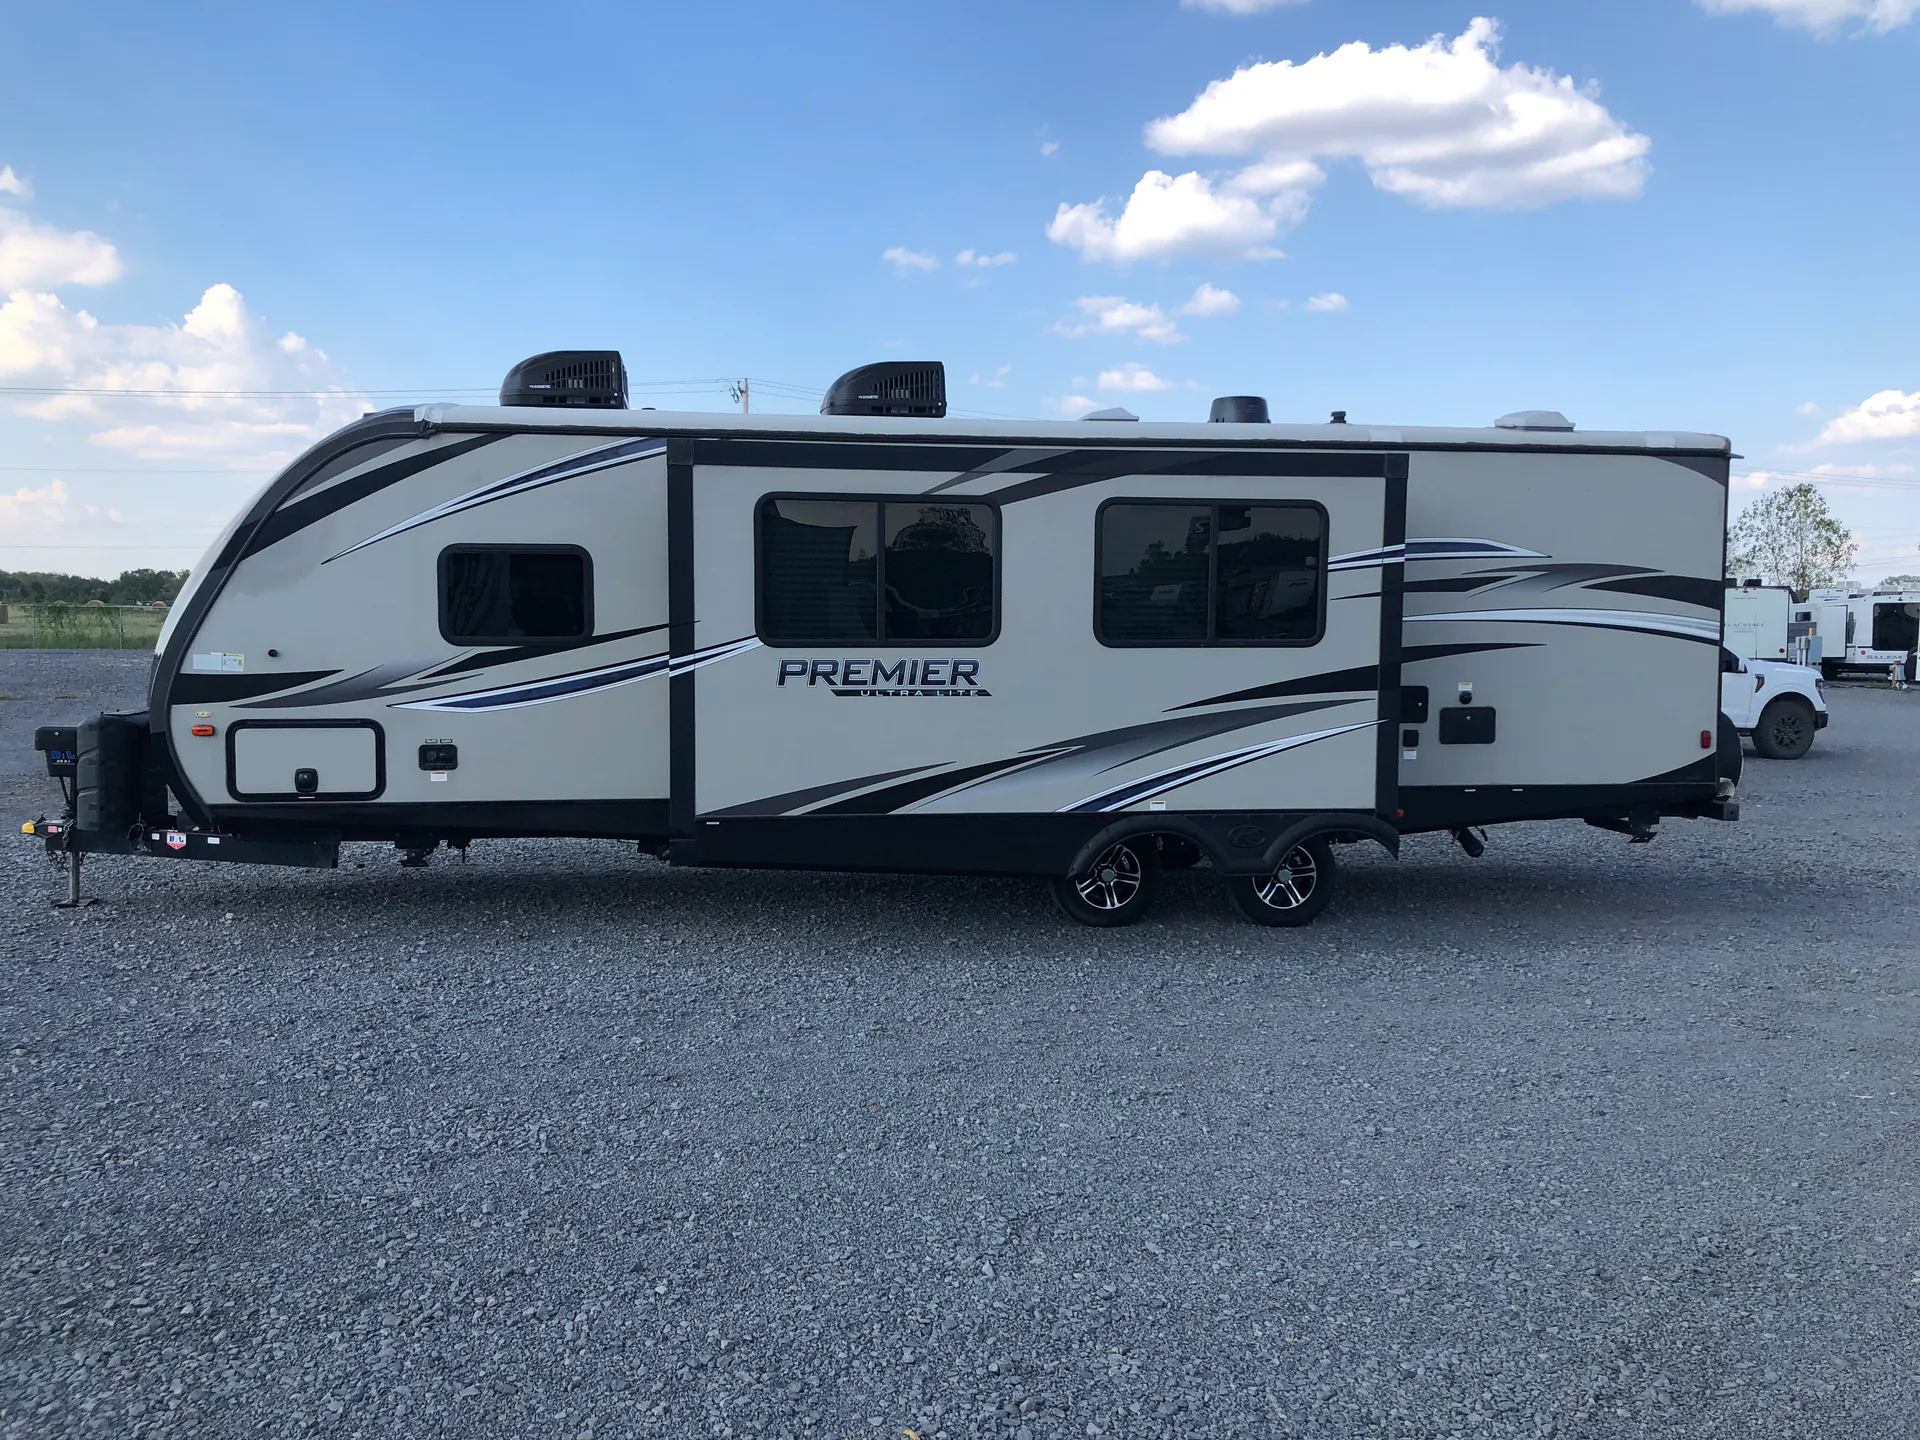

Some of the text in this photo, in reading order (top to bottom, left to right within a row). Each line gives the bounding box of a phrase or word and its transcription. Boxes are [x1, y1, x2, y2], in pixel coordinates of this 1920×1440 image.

[777, 658, 981, 687] PREMIER
[860, 689, 979, 697] ULTRA LITE
